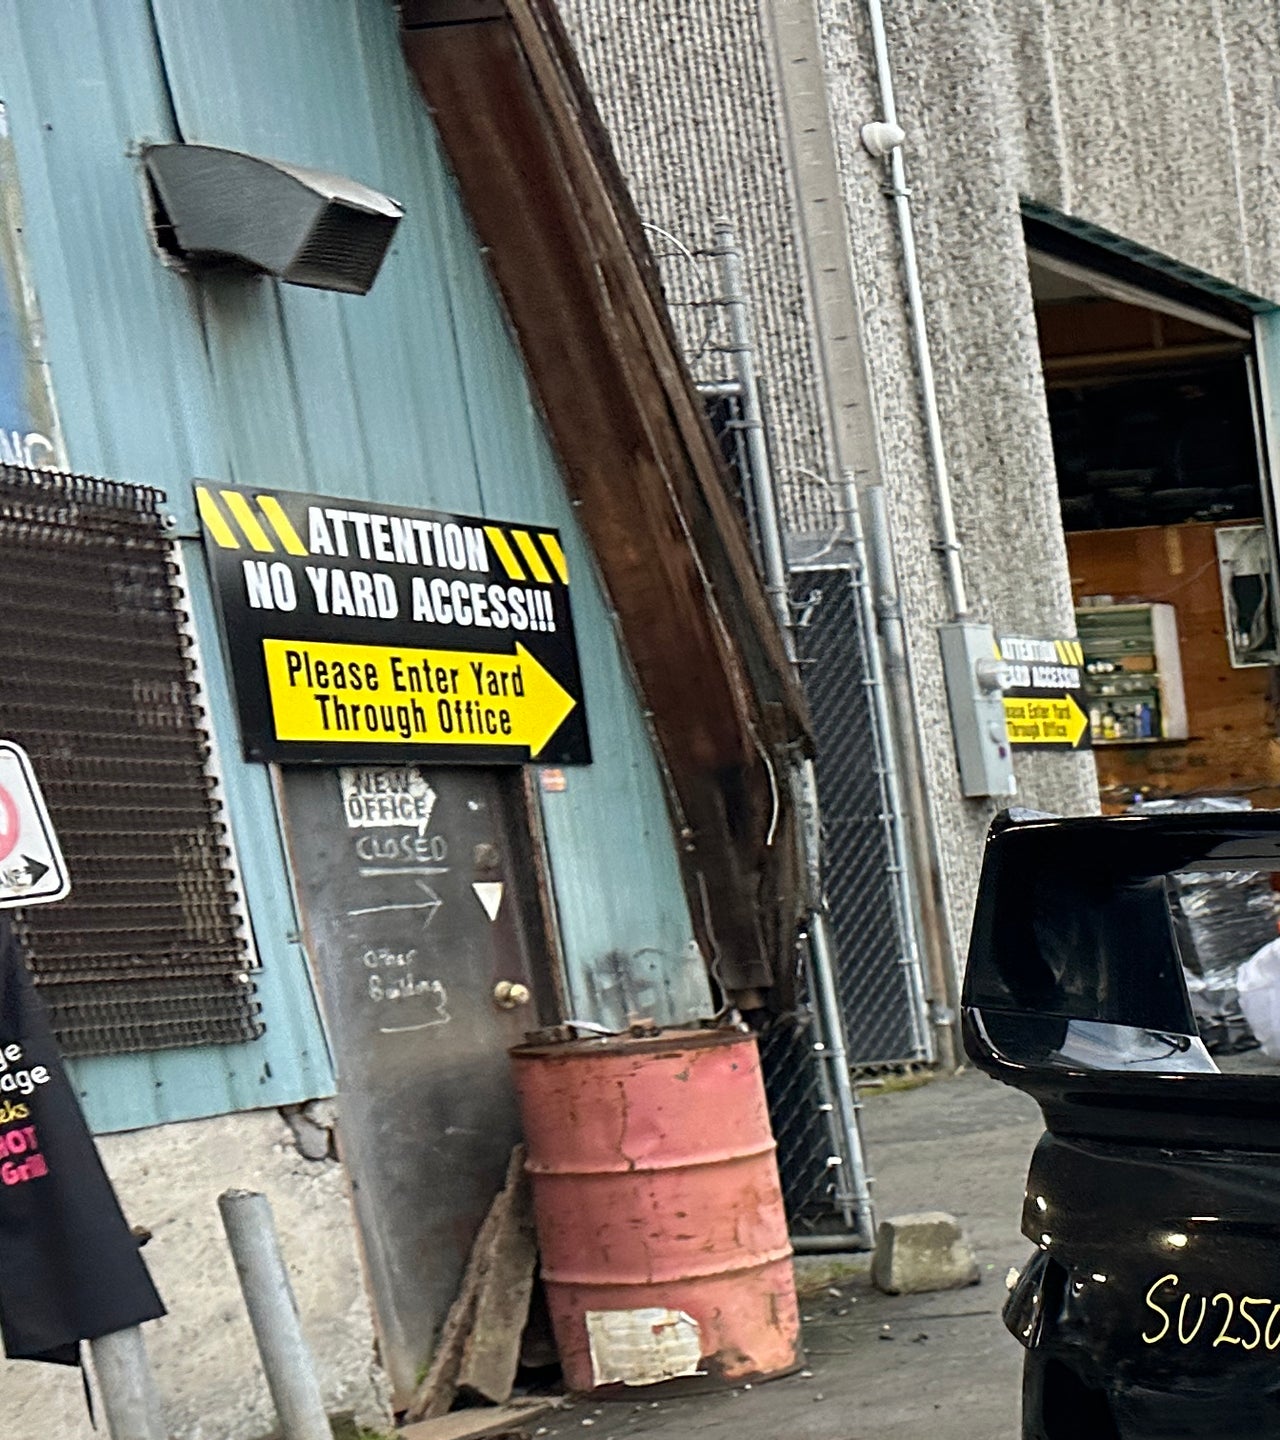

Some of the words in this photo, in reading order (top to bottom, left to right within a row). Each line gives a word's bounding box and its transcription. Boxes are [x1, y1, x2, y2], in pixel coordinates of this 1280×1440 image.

[308, 507, 490, 573] ATTENTION
[243, 560, 297, 612] NO
[305, 566, 399, 619] YARD
[412, 577, 556, 633] ACCESS!!!
[285, 650, 380, 691] Please
[390, 656, 459, 695] Enter
[470, 661, 525, 698] Yard
[314, 694, 427, 739] Through
[437, 700, 512, 735] Office
[348, 794, 427, 822] OFFICE
[355, 834, 449, 862] CLOSED
[0, 1065, 51, 1095] age
